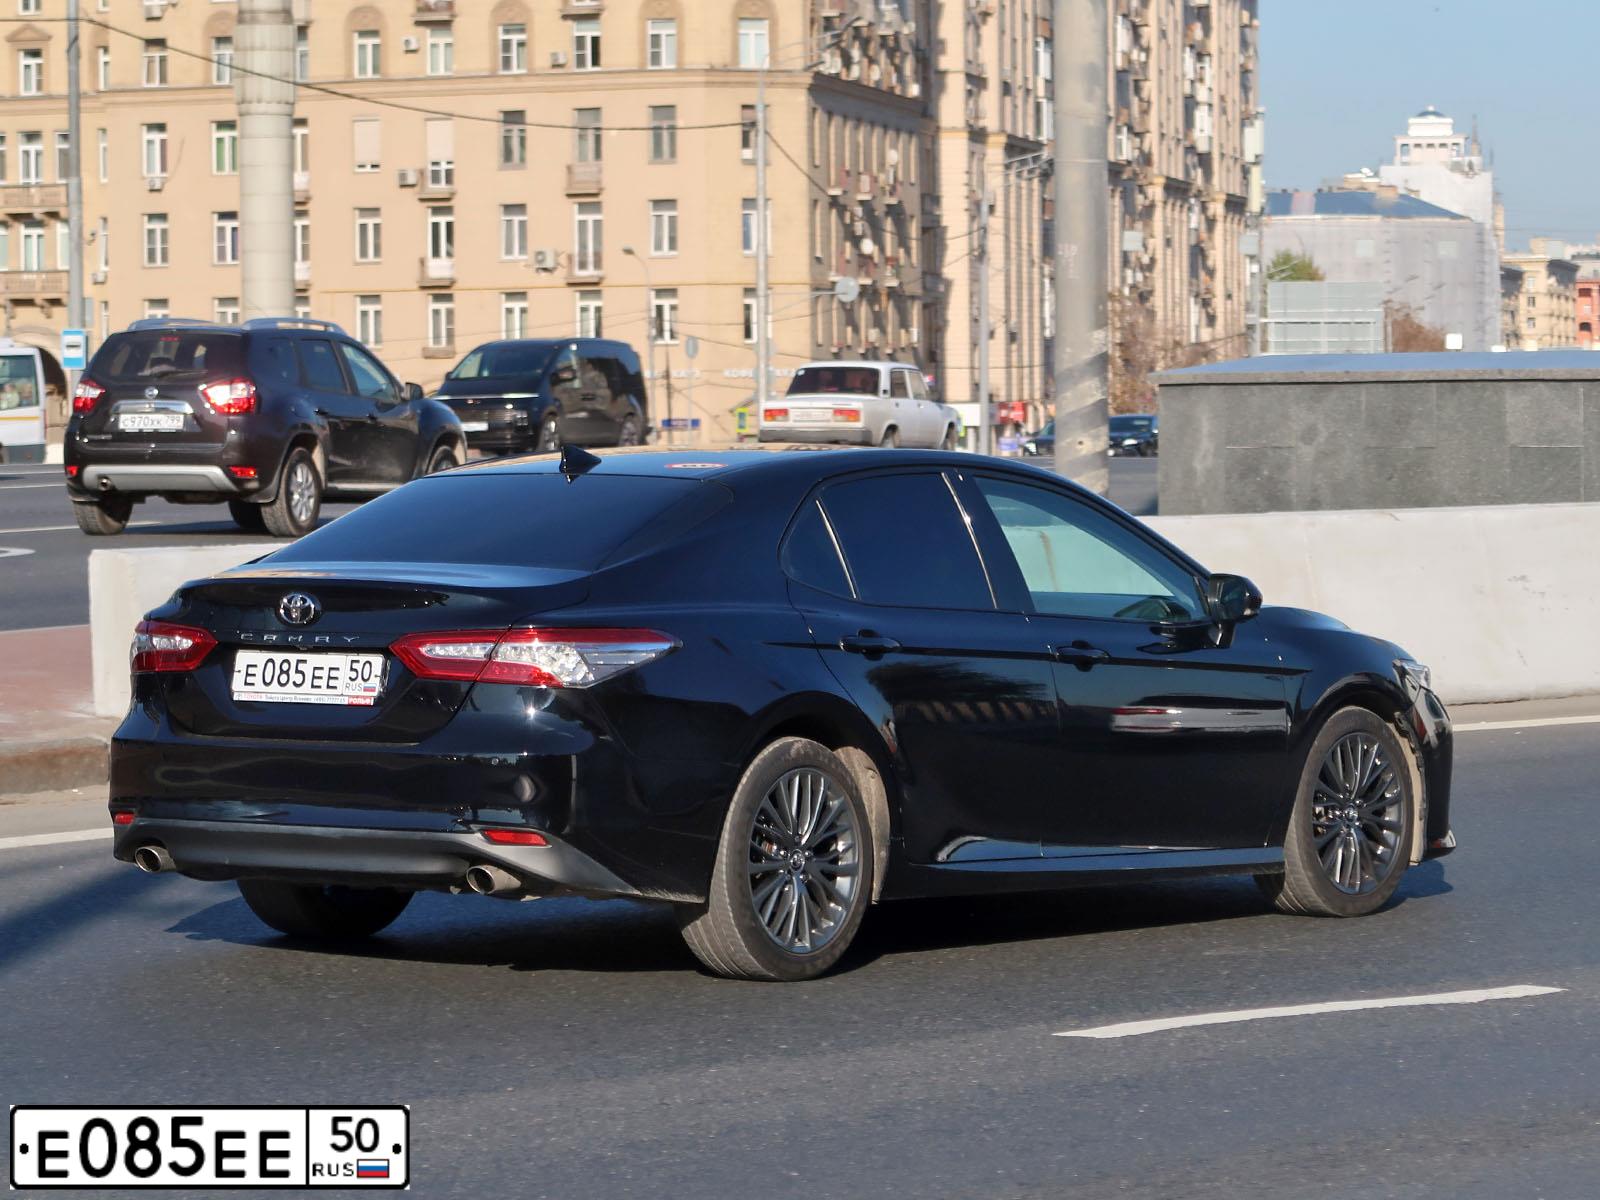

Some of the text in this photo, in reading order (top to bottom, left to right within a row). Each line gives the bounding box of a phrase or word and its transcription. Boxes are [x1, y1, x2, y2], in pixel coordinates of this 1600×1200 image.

[240, 633, 360, 644] CAMRY
[243, 657, 373, 690] E085EE 50
[345, 683, 362, 692] RUS
